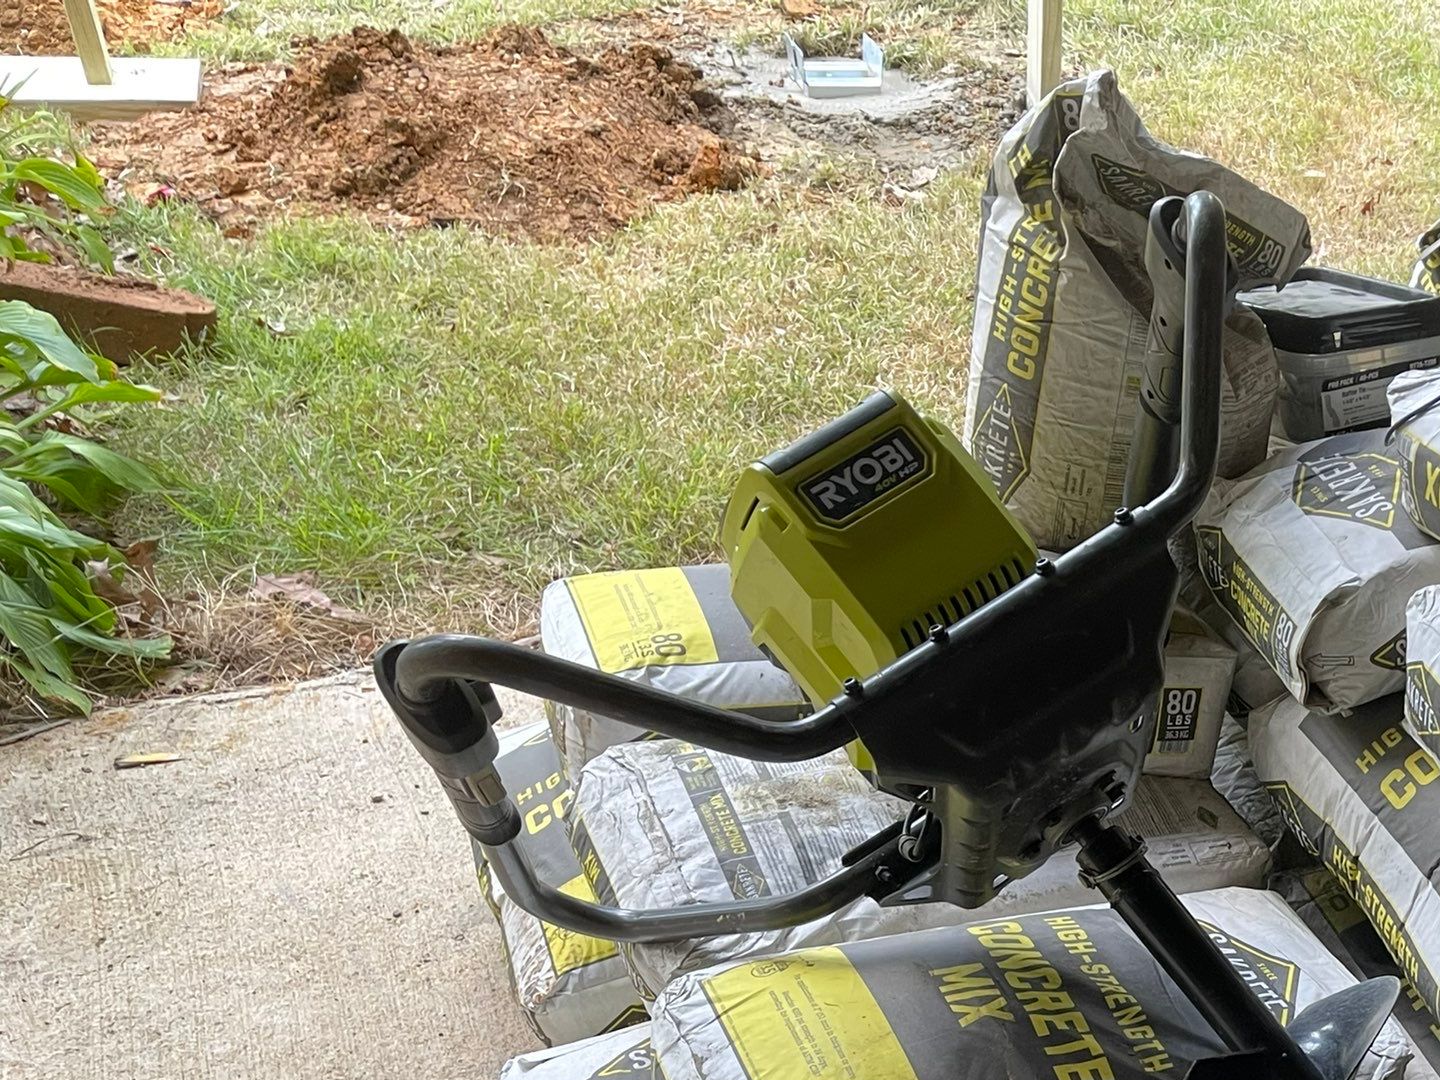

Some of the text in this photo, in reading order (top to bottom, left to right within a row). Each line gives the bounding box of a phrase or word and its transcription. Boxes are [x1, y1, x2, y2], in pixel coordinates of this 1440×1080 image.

[1258, 240, 1283, 269] 80
[984, 398, 1012, 500] KRETE
[810, 438, 914, 510] RYOBI
[651, 633, 687, 656] 80
[1275, 612, 1293, 648] 80
[1166, 689, 1197, 715] 80
[1167, 714, 1193, 726] LBS
[1407, 677, 1437, 733] AKRETE
[1257, 962, 1280, 981] SINCE
[929, 962, 1016, 1029] MIX
[1043, 915, 1174, 1073] HIGH-STRENGTH
